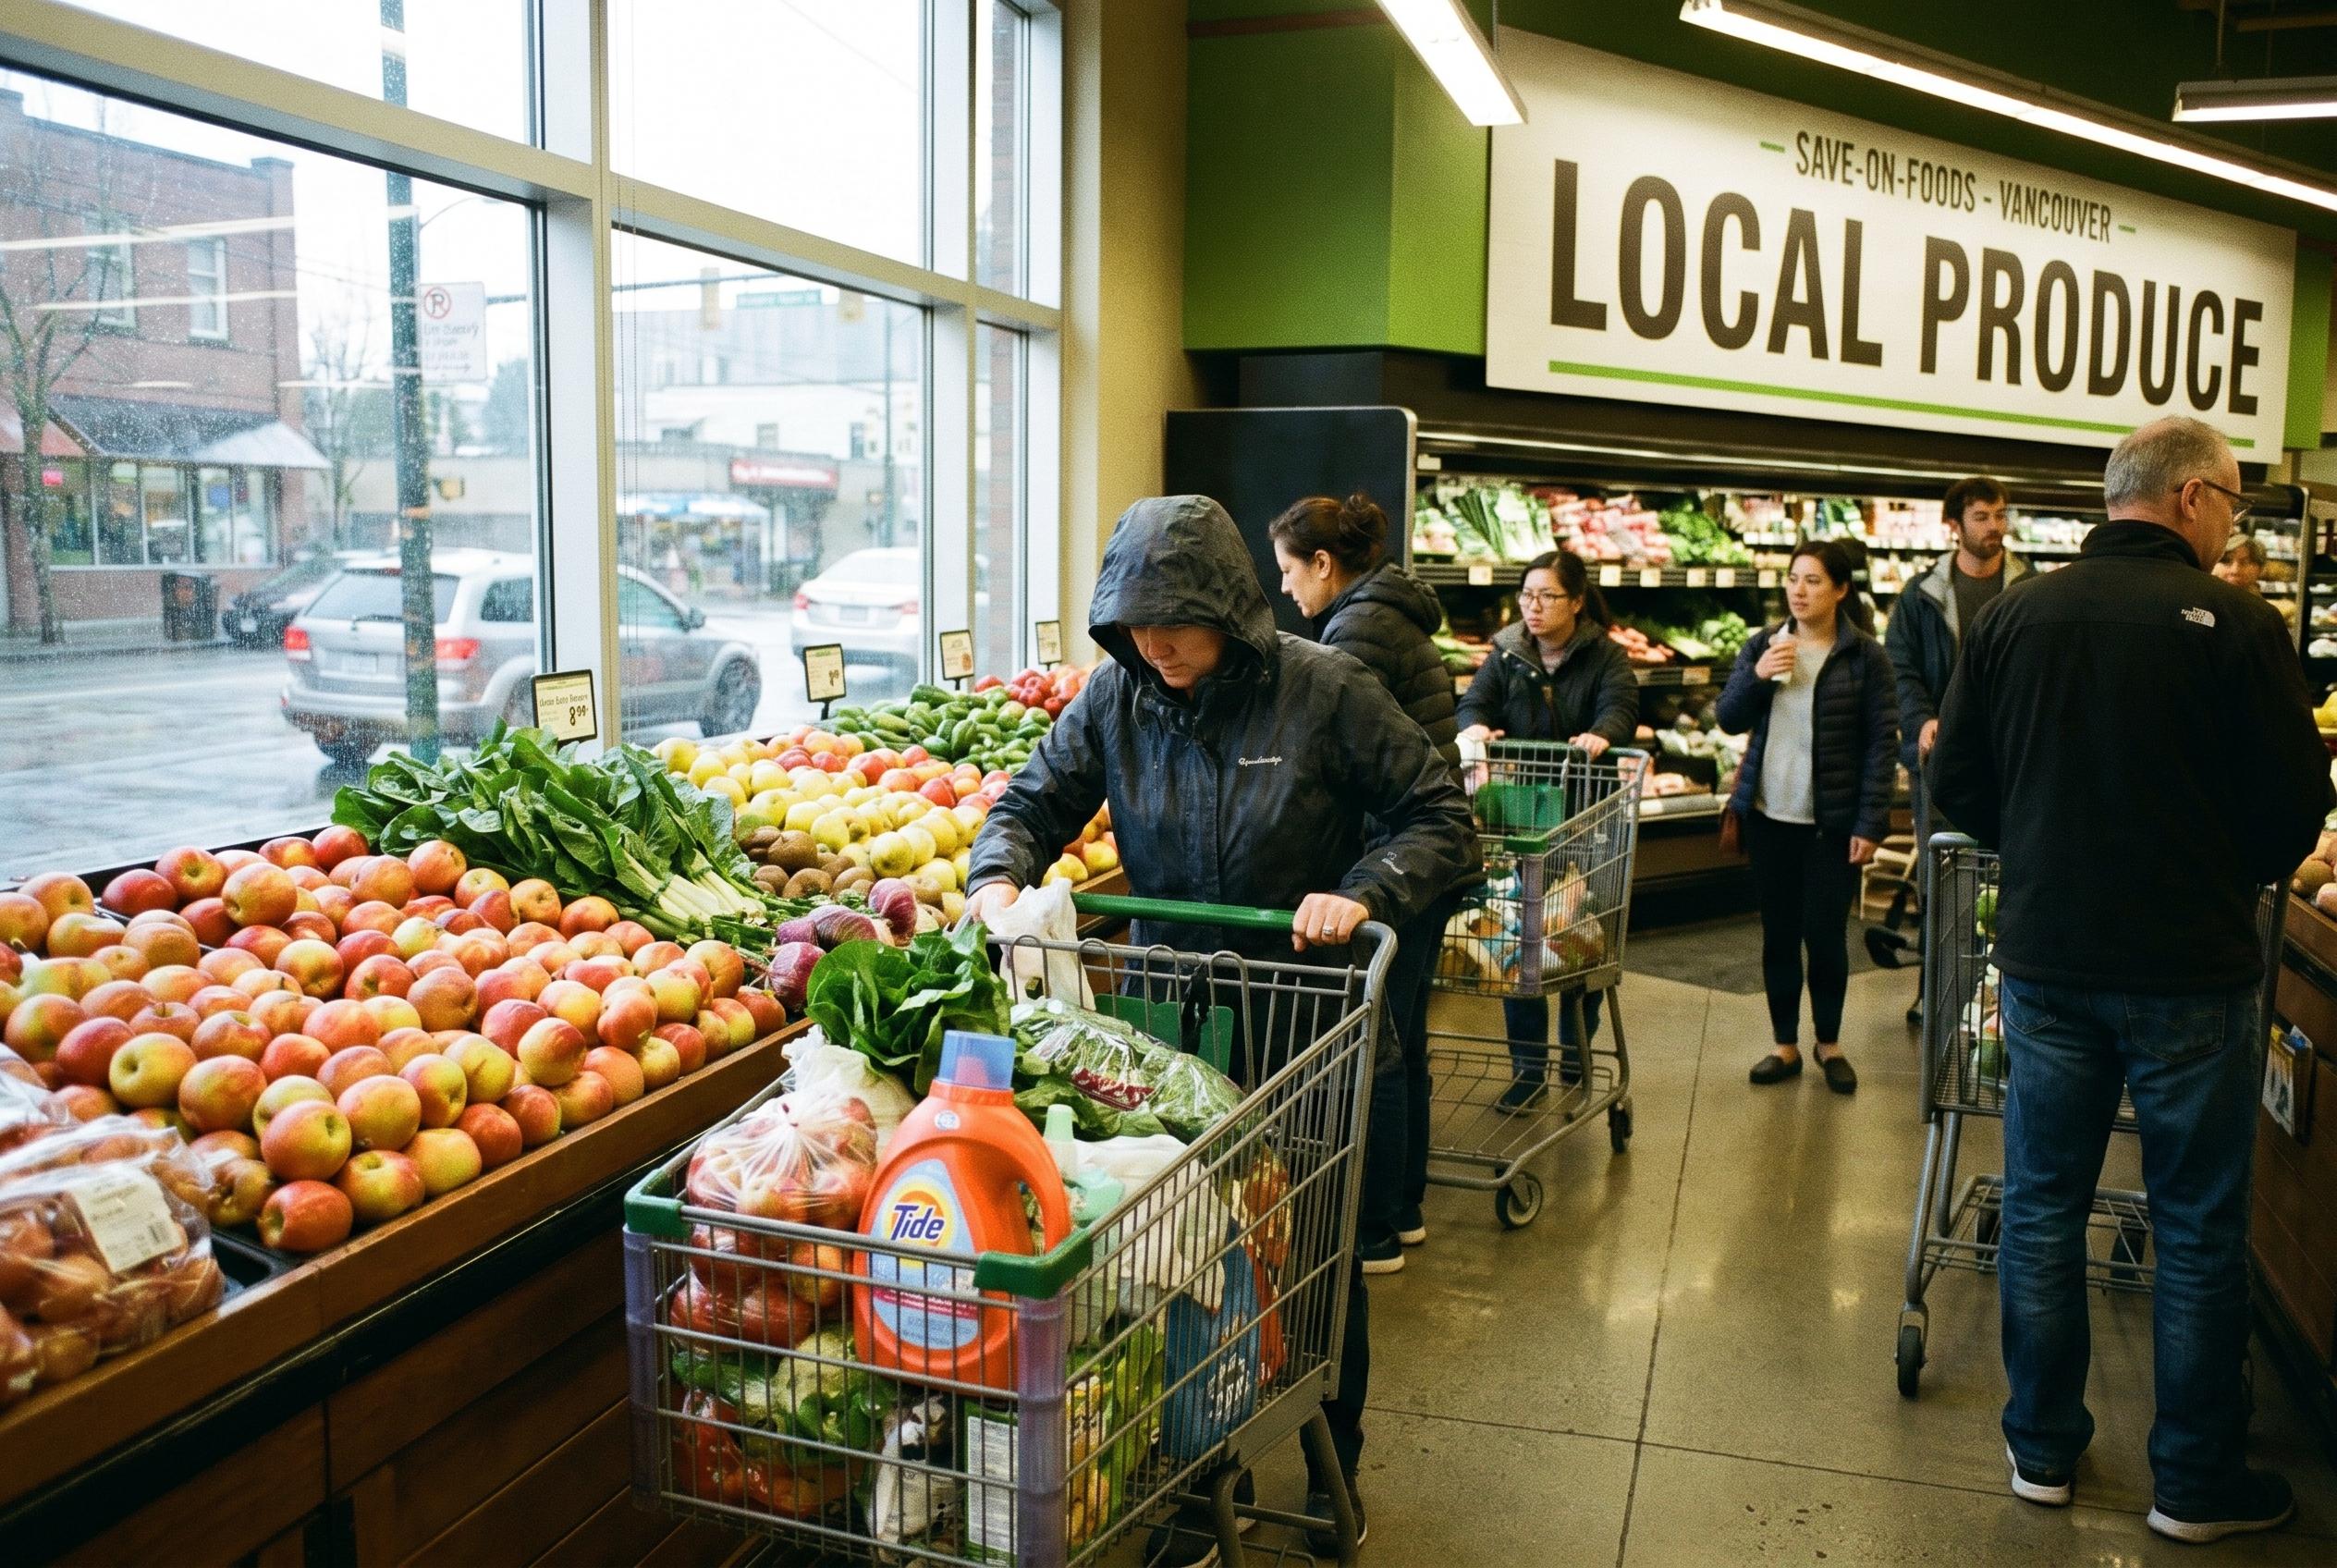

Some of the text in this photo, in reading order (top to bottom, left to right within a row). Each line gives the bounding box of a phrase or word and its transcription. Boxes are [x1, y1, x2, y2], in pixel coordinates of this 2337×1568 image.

[1795, 130, 1976, 214] SAVE-ON-FOODS
[1999, 179, 2111, 244] VANCOUVER
[1550, 158, 2264, 416] LOCAL PRODUCE
[890, 1205, 945, 1241] Tide
